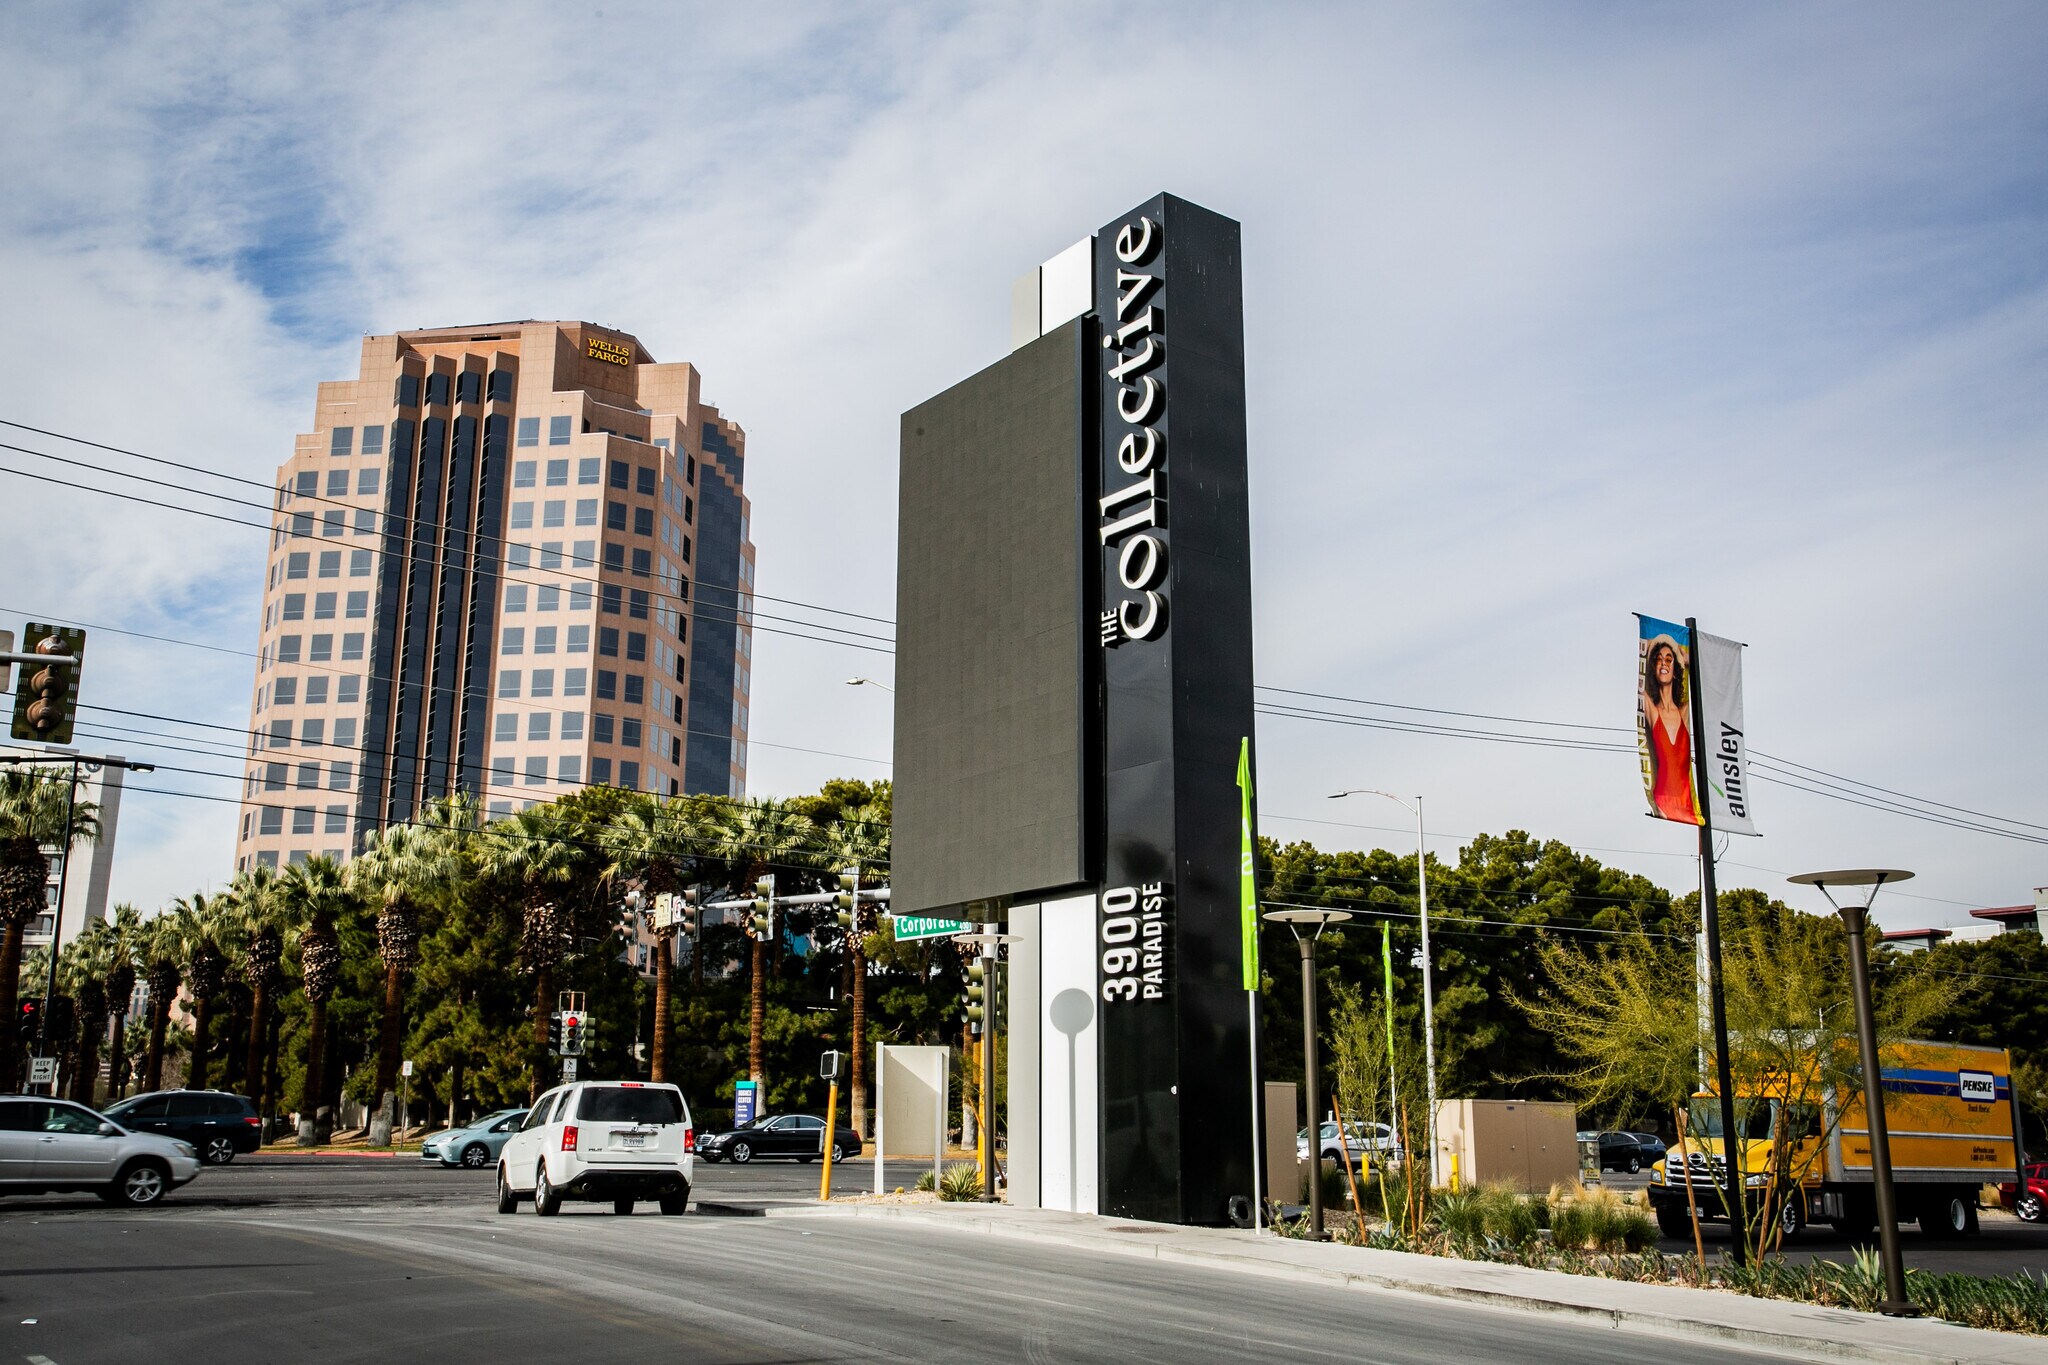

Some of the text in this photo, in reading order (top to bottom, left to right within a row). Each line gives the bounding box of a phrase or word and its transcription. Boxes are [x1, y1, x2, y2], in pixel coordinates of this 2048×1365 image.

[588, 338, 629, 357] WELLS
[588, 348, 628, 366] FARGO
[1099, 216, 1157, 639] collective
[1101, 607, 1117, 647] THE
[1637, 638, 1653, 791] REDEFINED
[1716, 721, 1746, 819] ainsley
[900, 917, 957, 935] Corporate
[1102, 886, 1137, 1001] 3900
[1142, 881, 1162, 998] PARADISE
[1962, 1080, 1992, 1092] PENSKE
